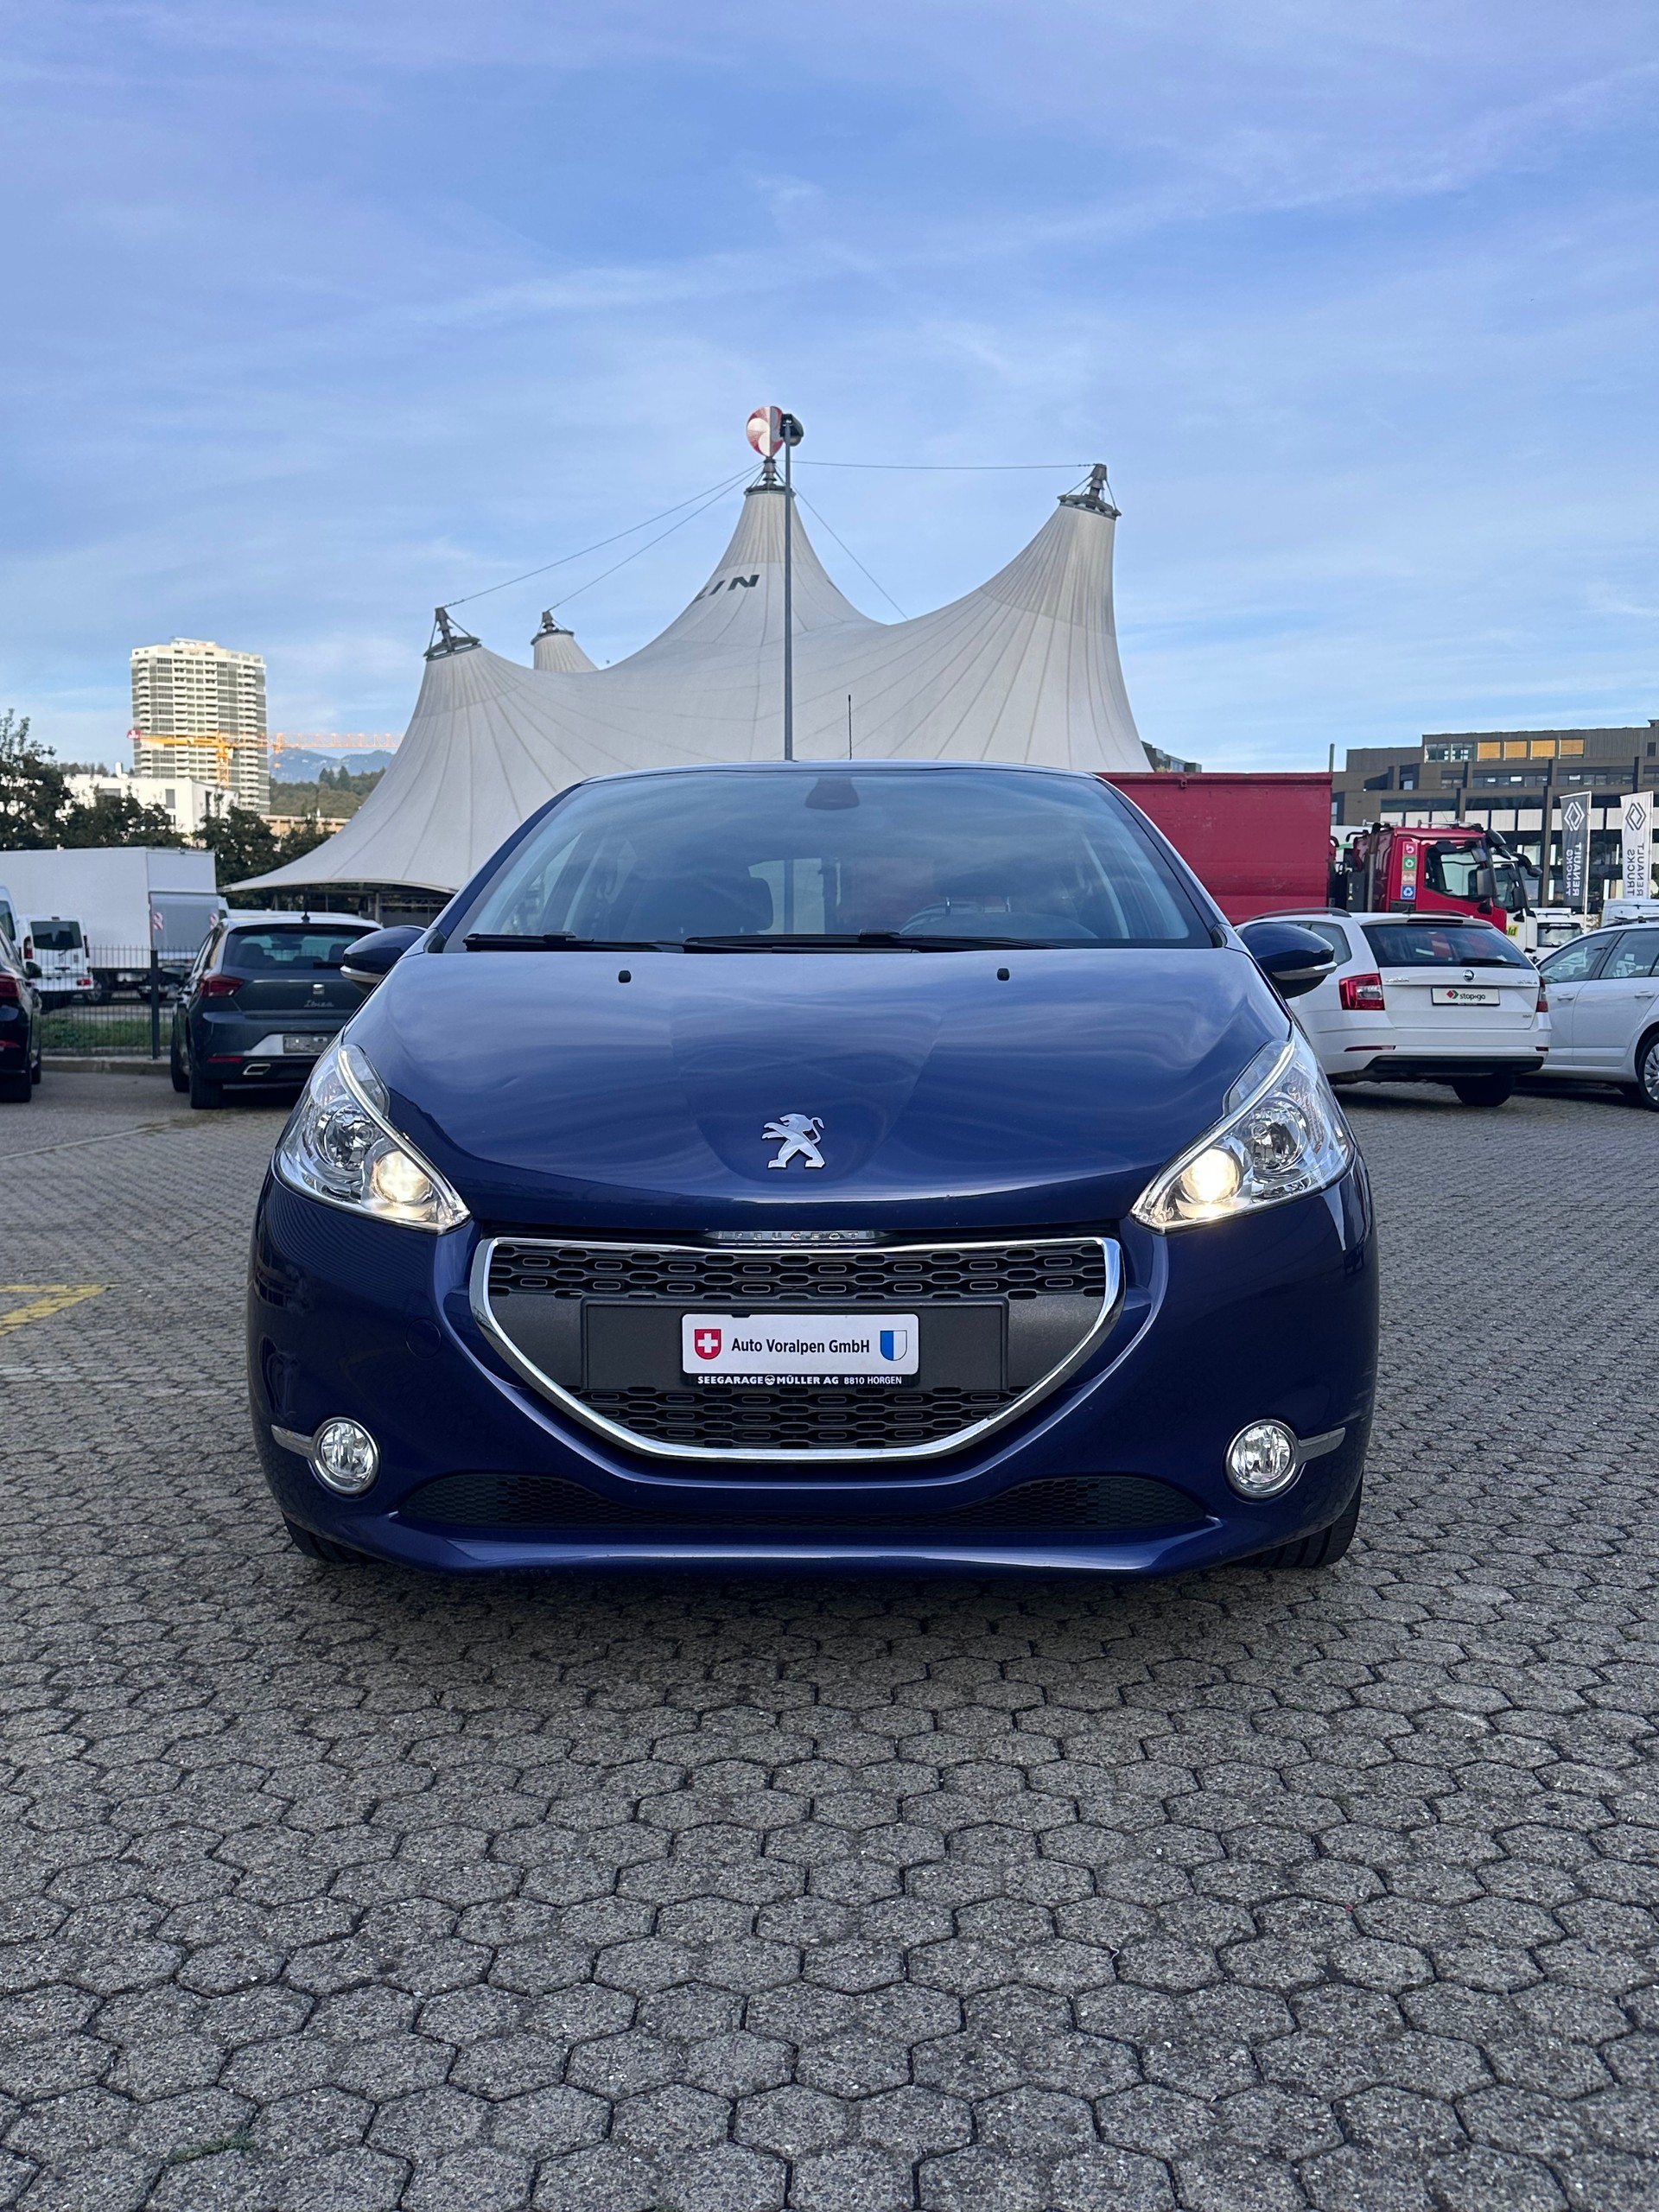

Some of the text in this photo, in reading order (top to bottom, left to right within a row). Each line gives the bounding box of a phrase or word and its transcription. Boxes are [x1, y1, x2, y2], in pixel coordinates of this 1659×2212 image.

[731, 1338, 870, 1356] Auto Voralpen GmbH
[697, 1376, 764, 1384] SEEGARAGE
[777, 1375, 821, 1384] MÜLLER
[823, 1376, 839, 1385] AG
[867, 1376, 902, 1384] HORGEN
